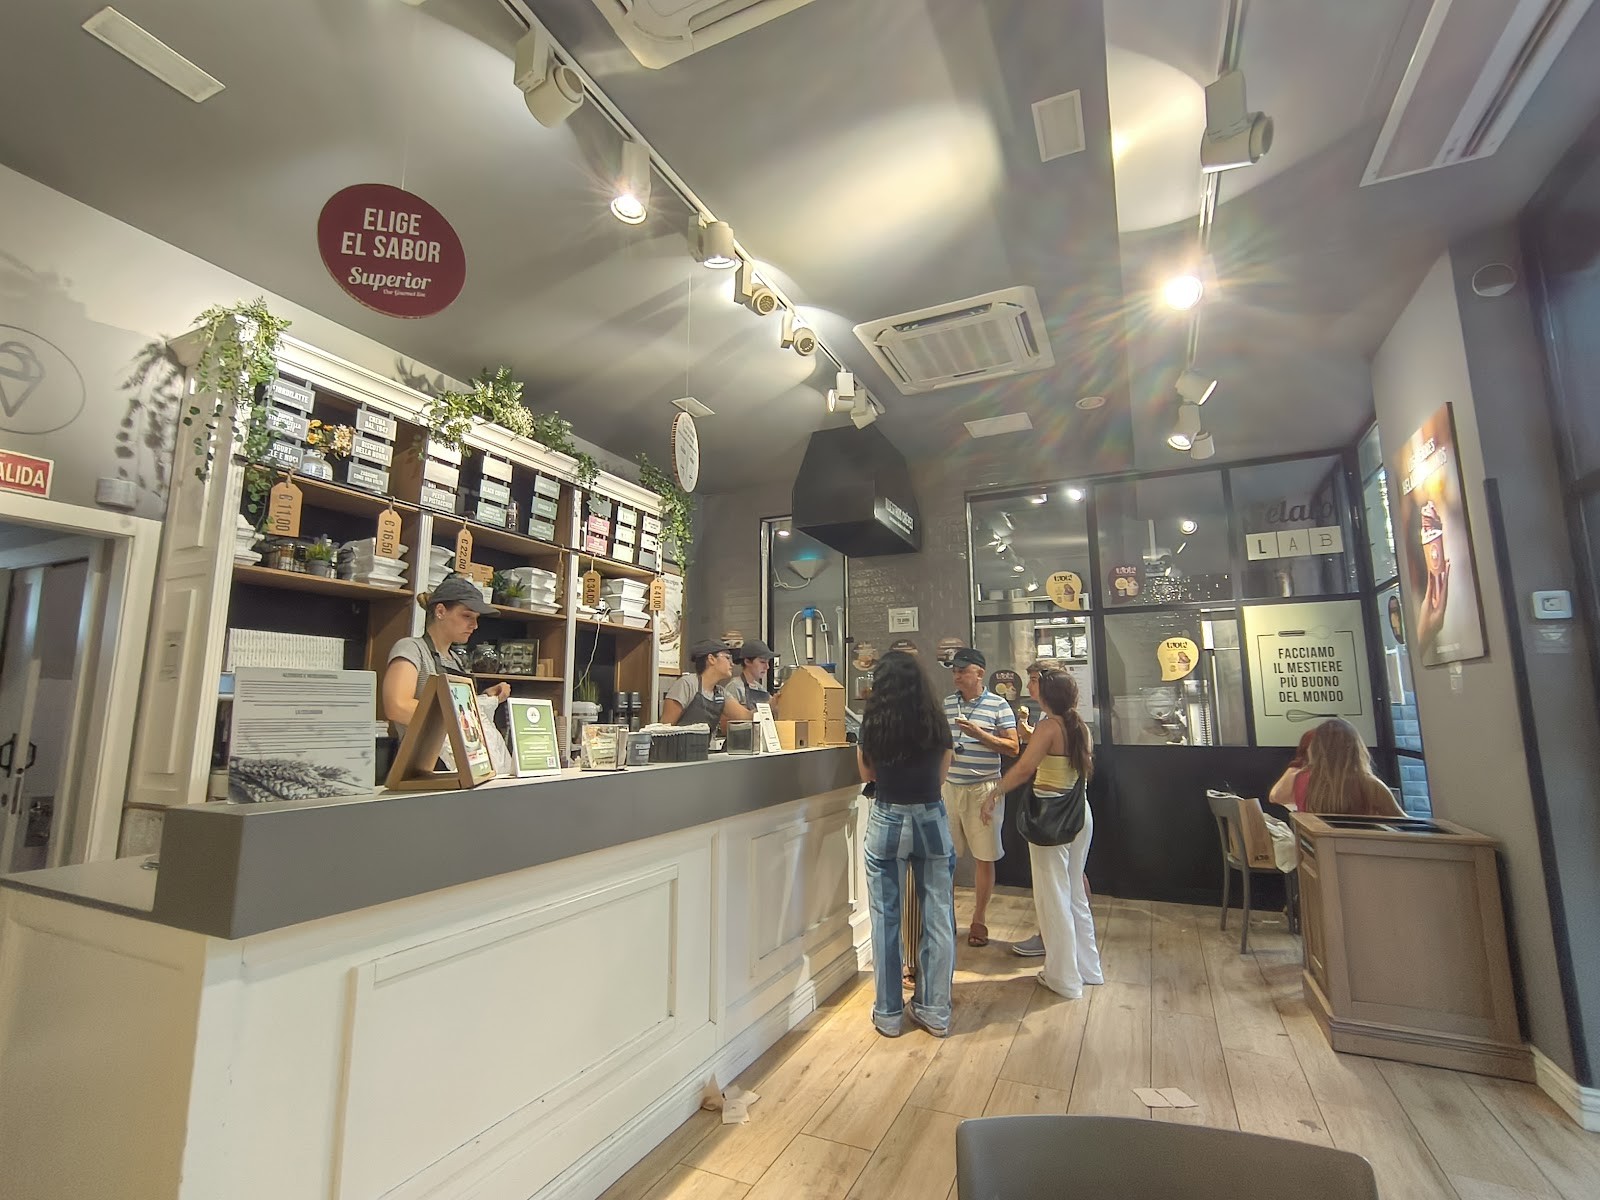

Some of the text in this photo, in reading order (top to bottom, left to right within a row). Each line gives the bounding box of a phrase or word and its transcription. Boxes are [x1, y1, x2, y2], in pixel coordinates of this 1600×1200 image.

[363, 207, 422, 236] ELIGE
[341, 231, 441, 263] EL SABOR
[348, 266, 432, 291] Superior
[275, 505, 291, 531] 11,00
[1264, 500, 1333, 524] elato
[382, 529, 394, 554] 16,50
[458, 546, 468, 570] 22,00
[1278, 646, 1335, 659] FACCIAMO
[1273, 660, 1343, 674] IL MESTIERE
[1280, 674, 1339, 688] PIÙ BUONO
[1279, 690, 1344, 702] DEL MONDO
